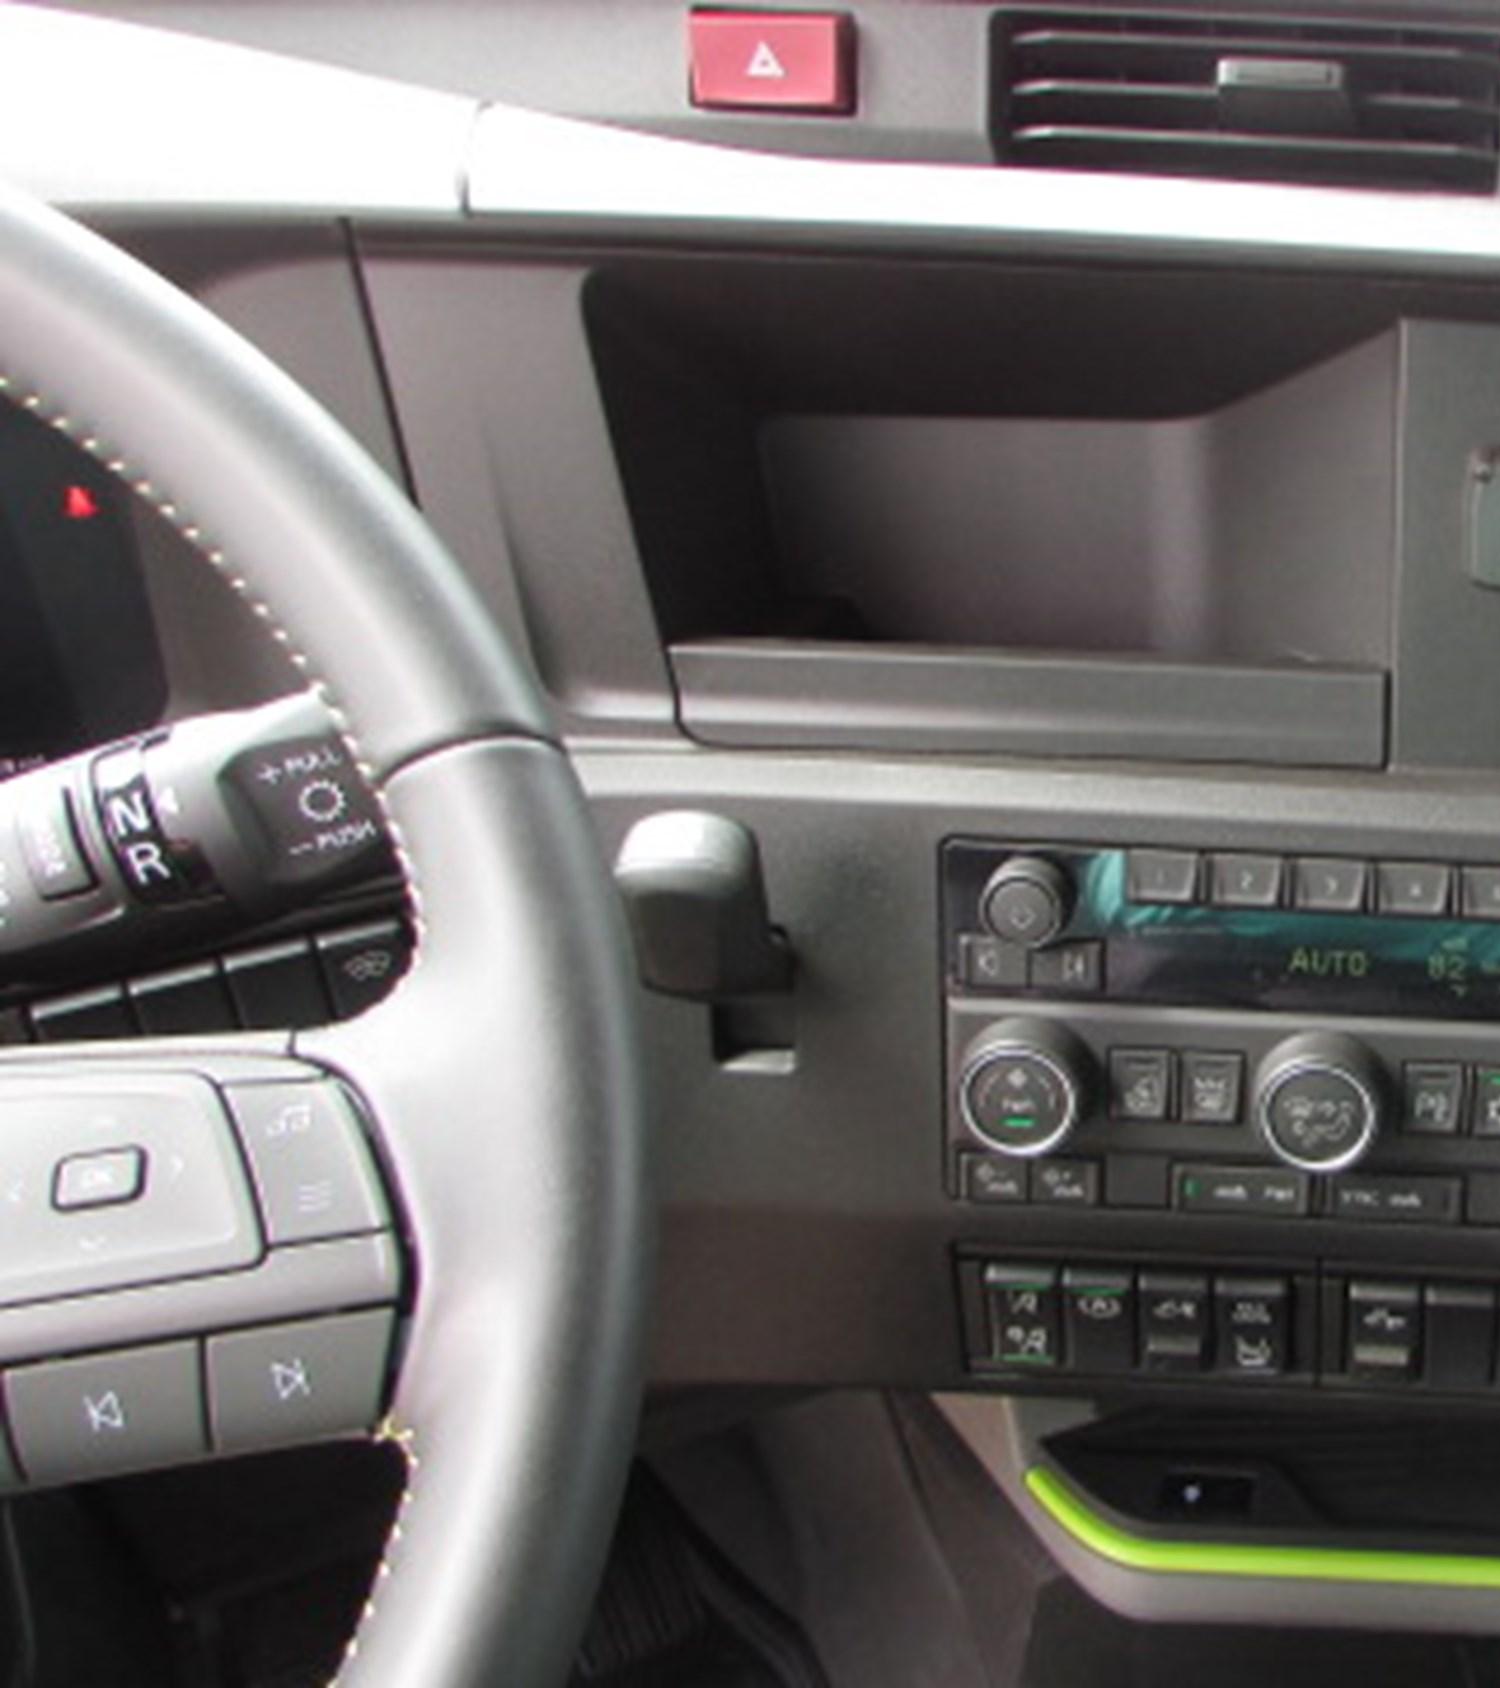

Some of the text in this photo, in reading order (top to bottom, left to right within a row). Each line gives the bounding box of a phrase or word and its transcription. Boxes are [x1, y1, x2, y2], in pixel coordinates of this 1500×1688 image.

[284, 747, 343, 776] PULL
[110, 789, 151, 837] N
[316, 818, 377, 850] PUSH
[126, 841, 171, 885] R
[1288, 947, 1367, 978] AUTO
